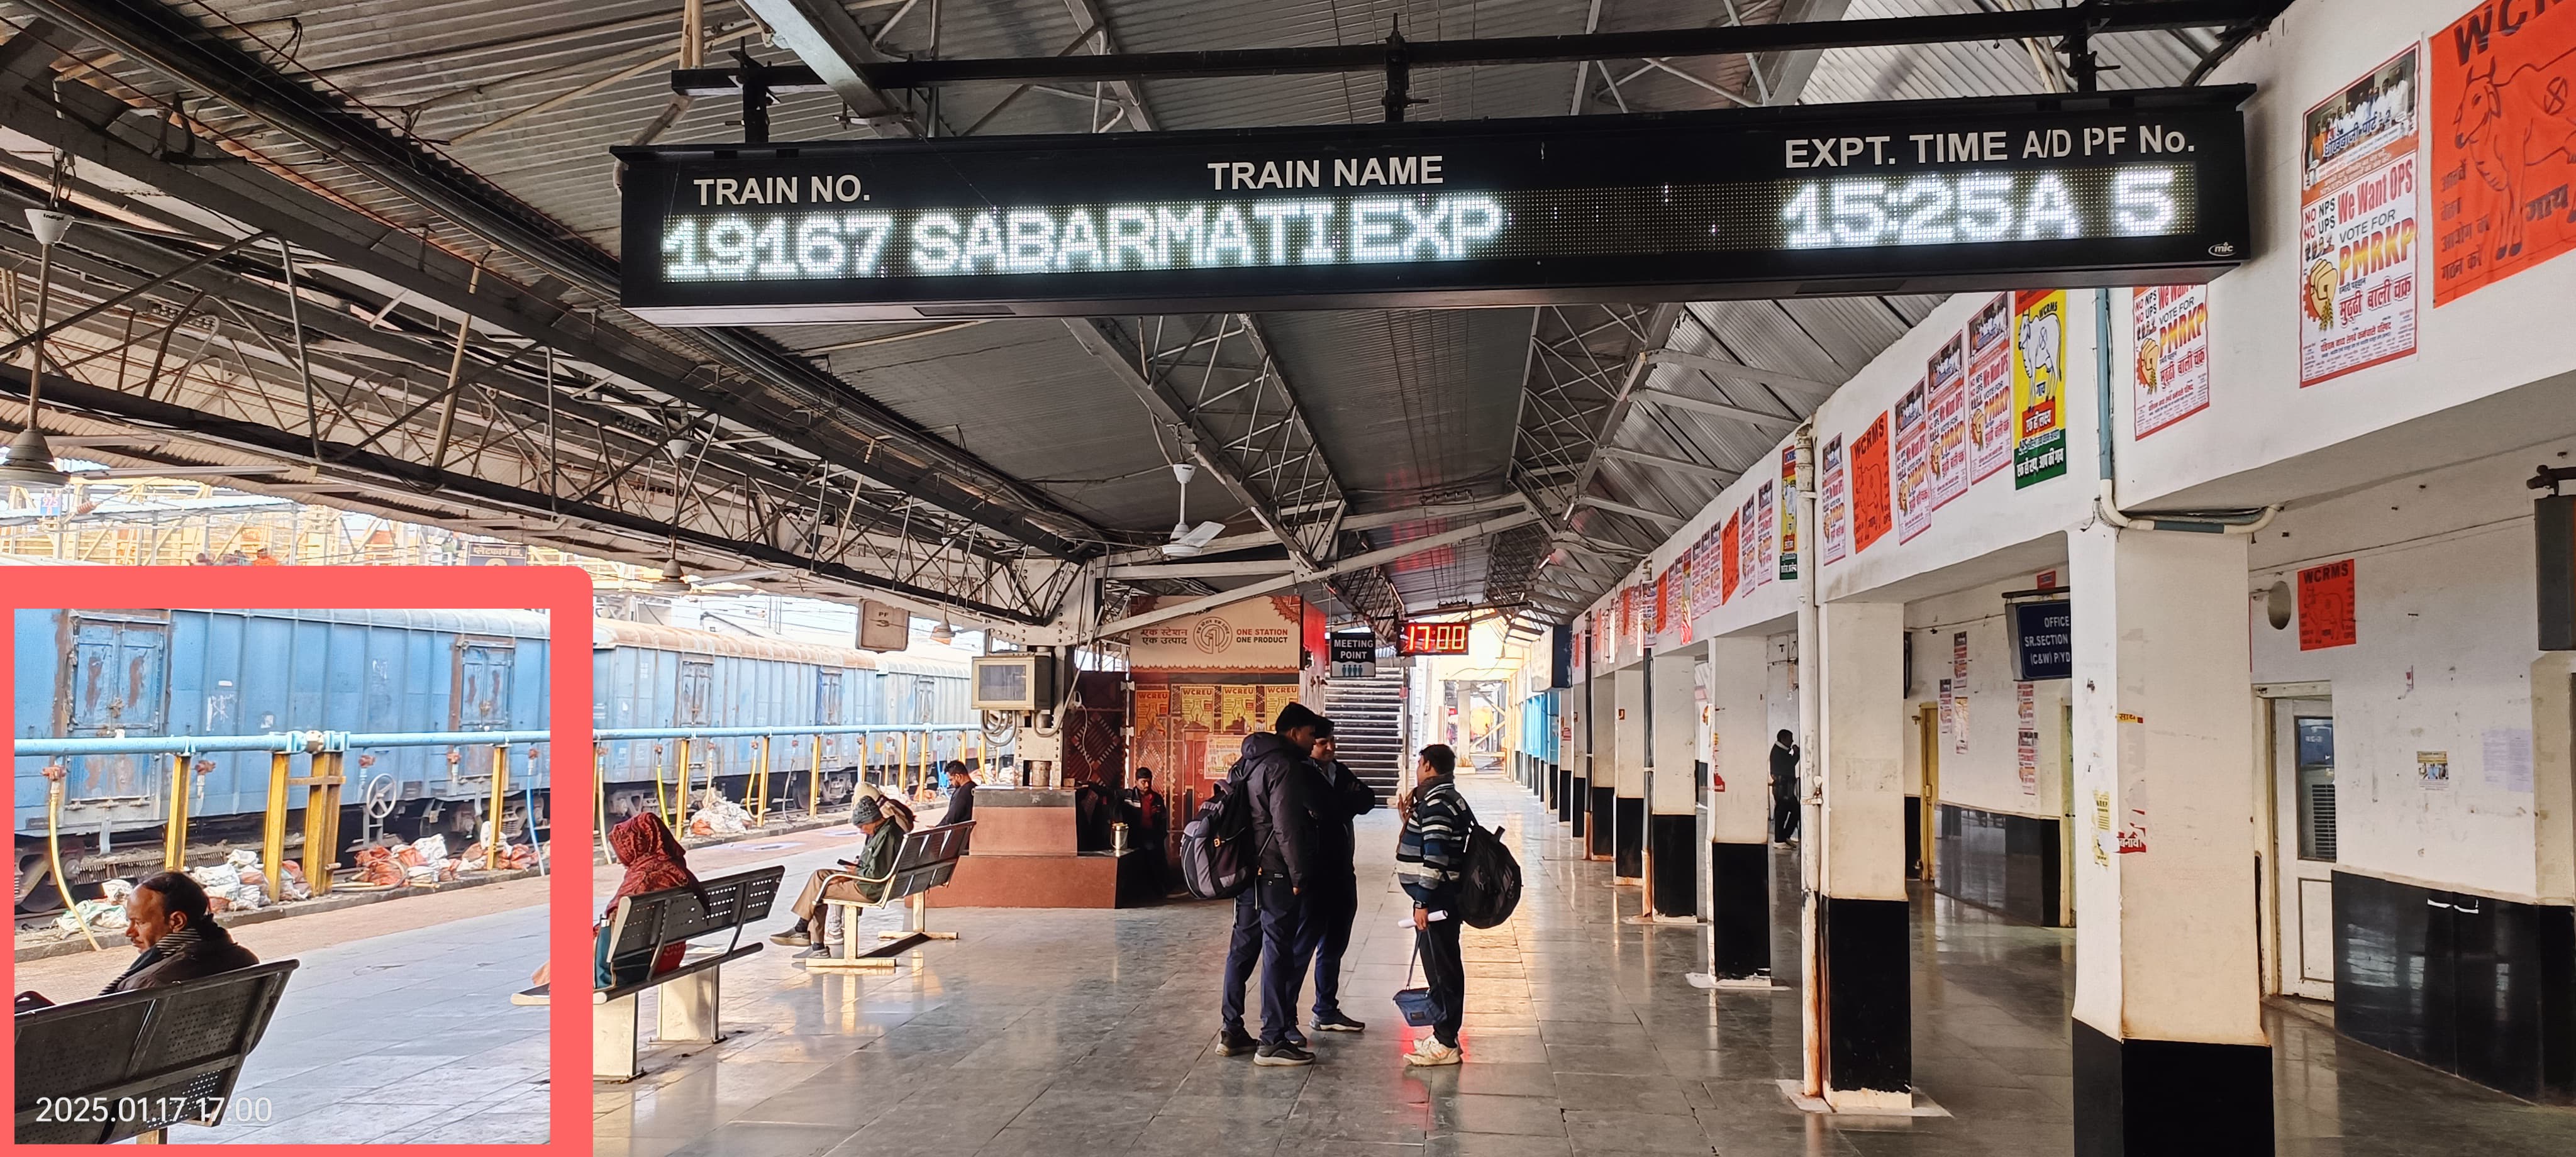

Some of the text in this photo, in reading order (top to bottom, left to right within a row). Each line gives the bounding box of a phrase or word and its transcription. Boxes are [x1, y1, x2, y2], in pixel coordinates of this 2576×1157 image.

[1785, 131, 2008, 169] EXPT. TIME
[2023, 129, 2072, 158] A/D
[2084, 125, 2195, 156] PF No.
[1208, 156, 1443, 191] TRAIN NAME
[694, 174, 869, 206] TRAIN NO.
[2114, 167, 2175, 236] 5
[2338, 191, 2355, 225] We
[2357, 174, 2387, 216] Want
[2390, 158, 2413, 201] OPS
[2305, 197, 2335, 225] NO NPS
[662, 192, 1504, 278] 19167 SABARMATI EXP
[2304, 215, 2335, 242] NO UPS
[2340, 209, 2396, 243] VOTE FOR
[2214, 241, 2233, 252] mic
[2338, 216, 2416, 286] PMRKP
[2136, 289, 2157, 311] NO NPS
[2136, 303, 2157, 325] NO UPS
[2159, 296, 2194, 325] VOTE FOR
[2159, 302, 2205, 359] PMRKP
[1854, 417, 1884, 462] WCRMS
[2304, 562, 2349, 585] WCRMS
[1160, 626, 1188, 636] स्टेशन
[2044, 616, 2070, 628] OFFICE
[1141, 636, 1188, 646] एक उत्पाद
[1334, 639, 1374, 648] MEETING
[1408, 624, 1466, 651] 17:00
[2024, 633, 2068, 647] SR.SECTION
[1340, 650, 1367, 660] POINT
